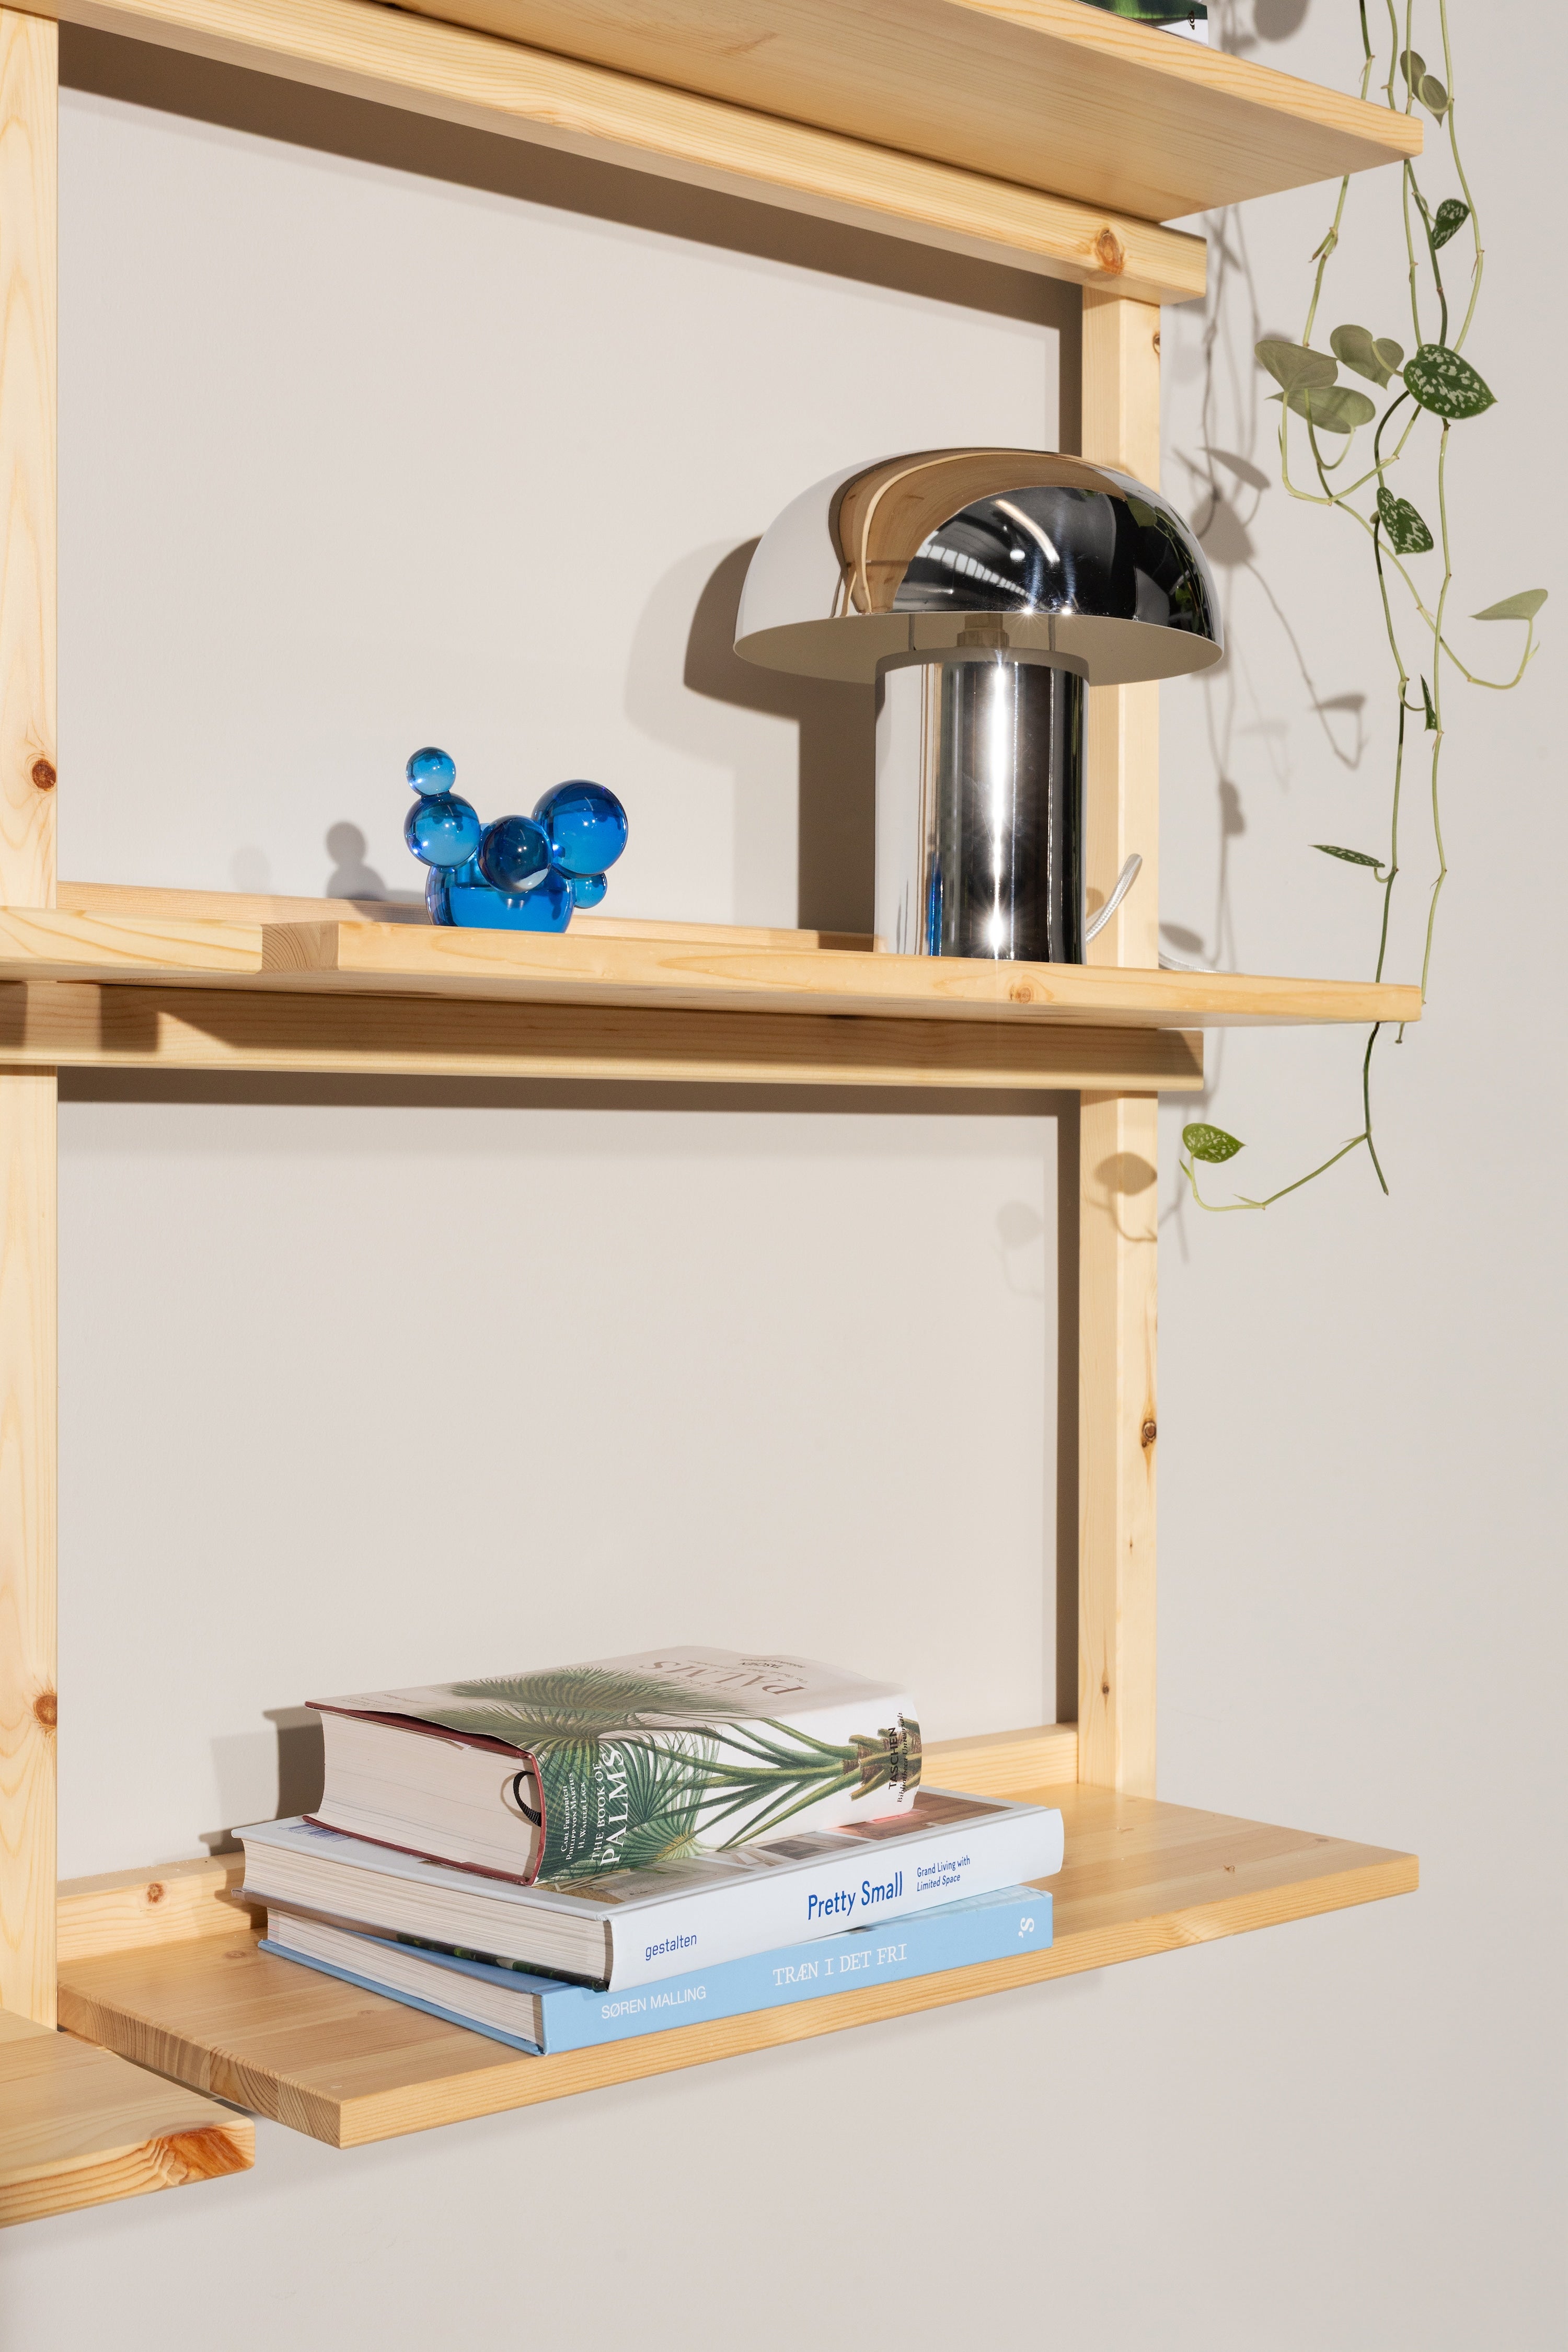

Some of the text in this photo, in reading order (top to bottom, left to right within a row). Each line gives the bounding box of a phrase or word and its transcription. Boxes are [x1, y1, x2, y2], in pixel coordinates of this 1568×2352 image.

[640, 1661, 807, 1695] PALMS
[888, 1727, 899, 1790] TASCHEN
[568, 1773, 577, 1809] MARTIUS
[601, 1749, 628, 1866] PALMS
[591, 1763, 606, 1861] THE BOOK OF
[560, 1831, 570, 1852] CARL
[565, 1829, 577, 1860] PHILIPP
[578, 1839, 586, 1849] H.
[917, 1854, 971, 1877] Grand Living with
[808, 1871, 903, 1920] Pretty Small
[917, 1874, 961, 1892] Limited Space
[645, 1934, 697, 1961] gestalten
[773, 1943, 908, 1986] TRÆN I DET FRI
[601, 1986, 707, 2020] SØREN MALLING
